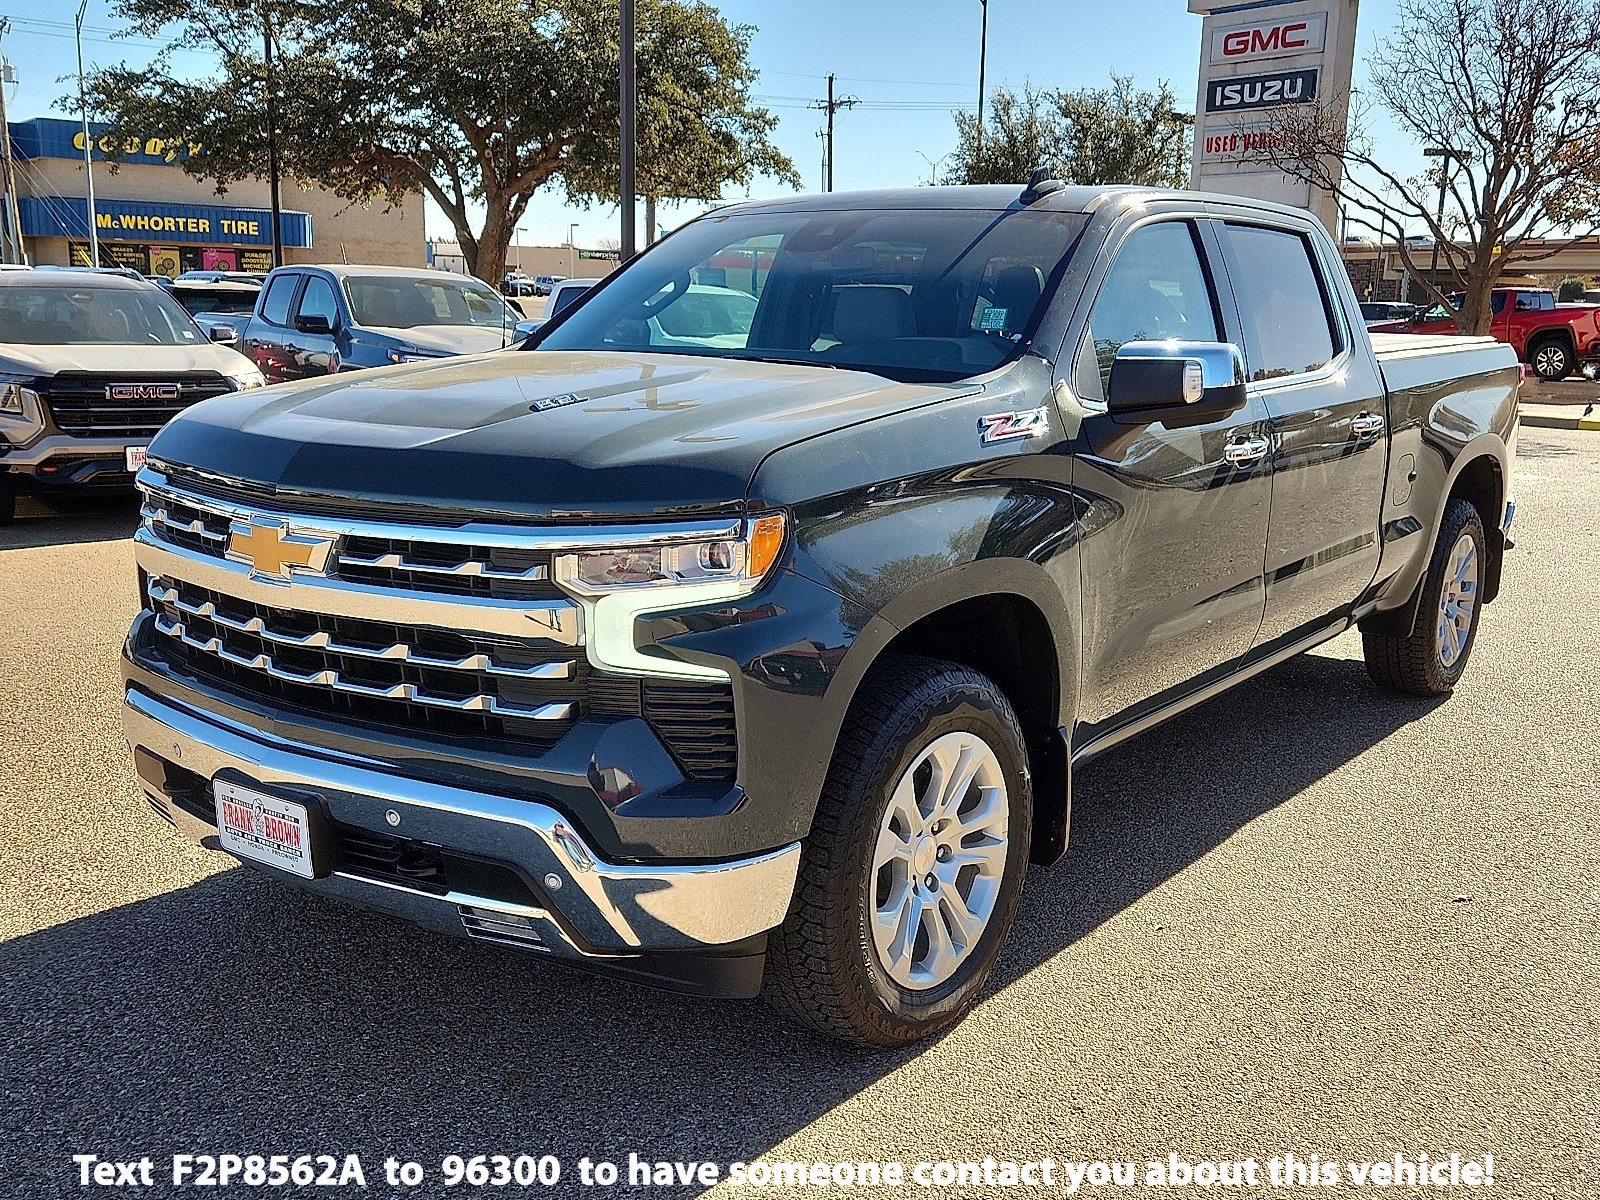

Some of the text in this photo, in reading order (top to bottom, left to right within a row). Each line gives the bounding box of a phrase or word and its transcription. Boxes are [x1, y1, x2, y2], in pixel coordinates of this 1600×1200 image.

[1223, 23, 1307, 56] GMC
[1215, 78, 1302, 106] ISUZU
[1206, 132, 1238, 153] USED
[97, 213, 259, 236] McWHORTER TIRE
[112, 386, 177, 399] GMC
[222, 801, 254, 834] FRANK
[264, 815, 302, 849] BROWN
[271, 848, 299, 862] PREOWNED
